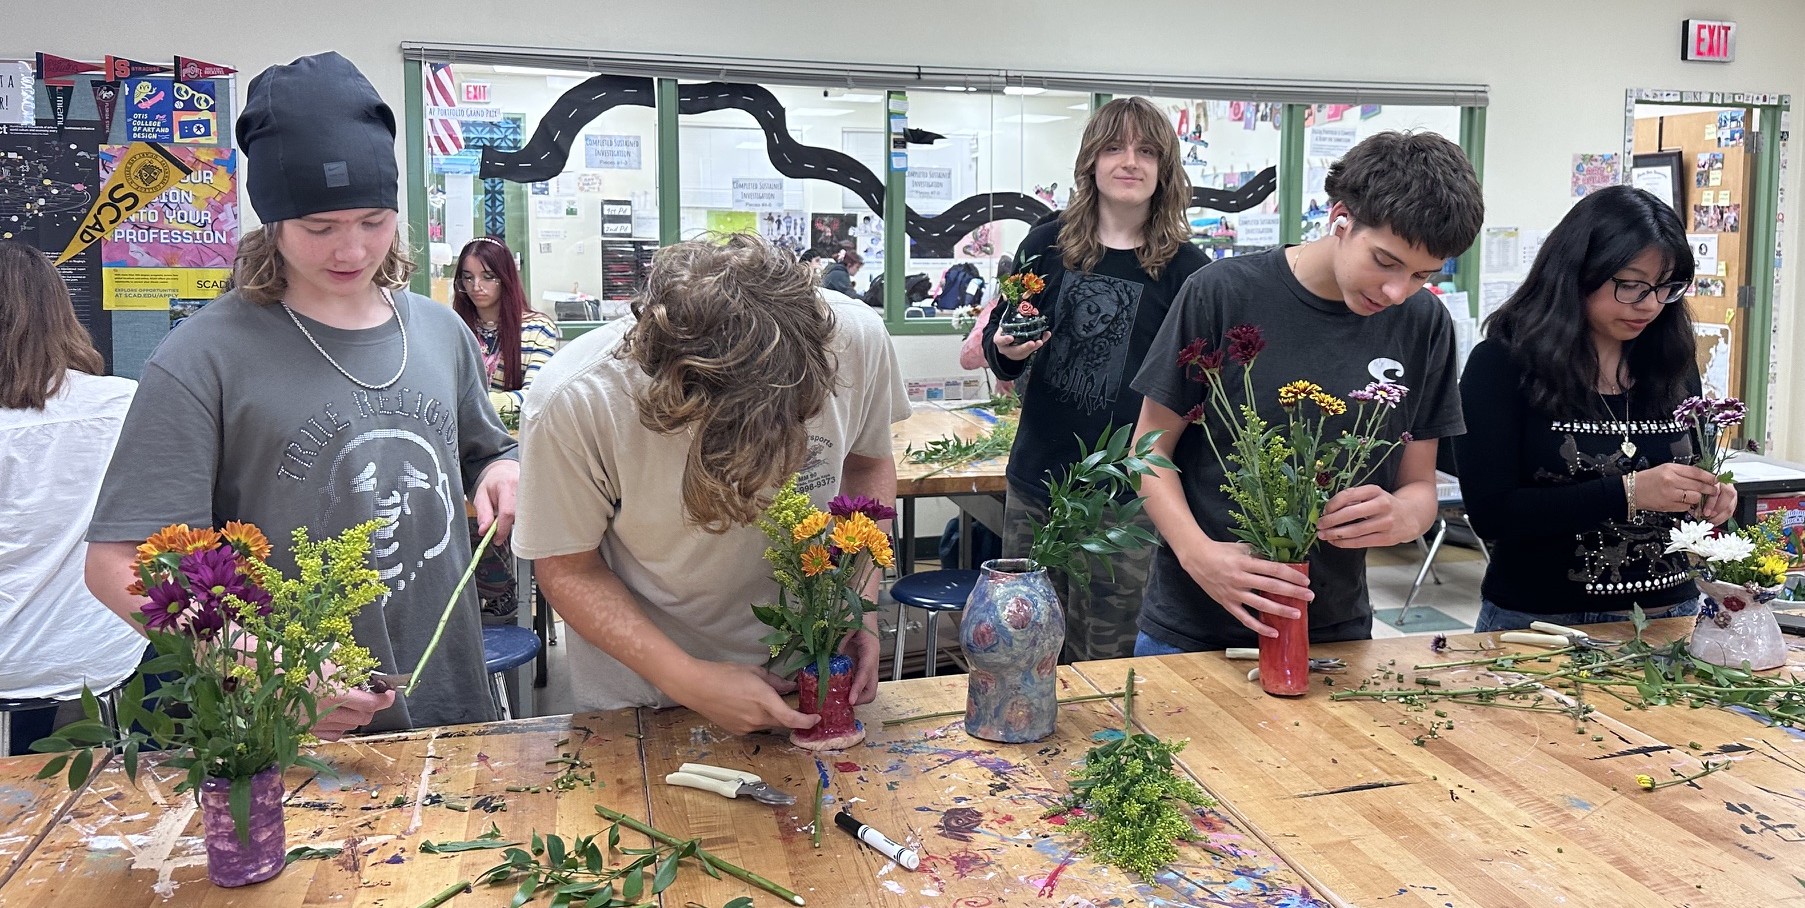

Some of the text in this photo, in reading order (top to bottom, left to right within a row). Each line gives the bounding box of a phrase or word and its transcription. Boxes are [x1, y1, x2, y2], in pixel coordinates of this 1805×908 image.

[1696, 24, 1731, 58] EXIT
[466, 85, 487, 100] EXIT
[80, 183, 139, 243] SCAD
[165, 210, 211, 224] YOUR
[115, 229, 227, 244] PROFESSION
[196, 280, 227, 289] SCAD
[352, 387, 458, 467] RELIGIO
[277, 402, 350, 482] TRUE
[809, 434, 833, 449] sports
[794, 476, 836, 494] -998-9373
